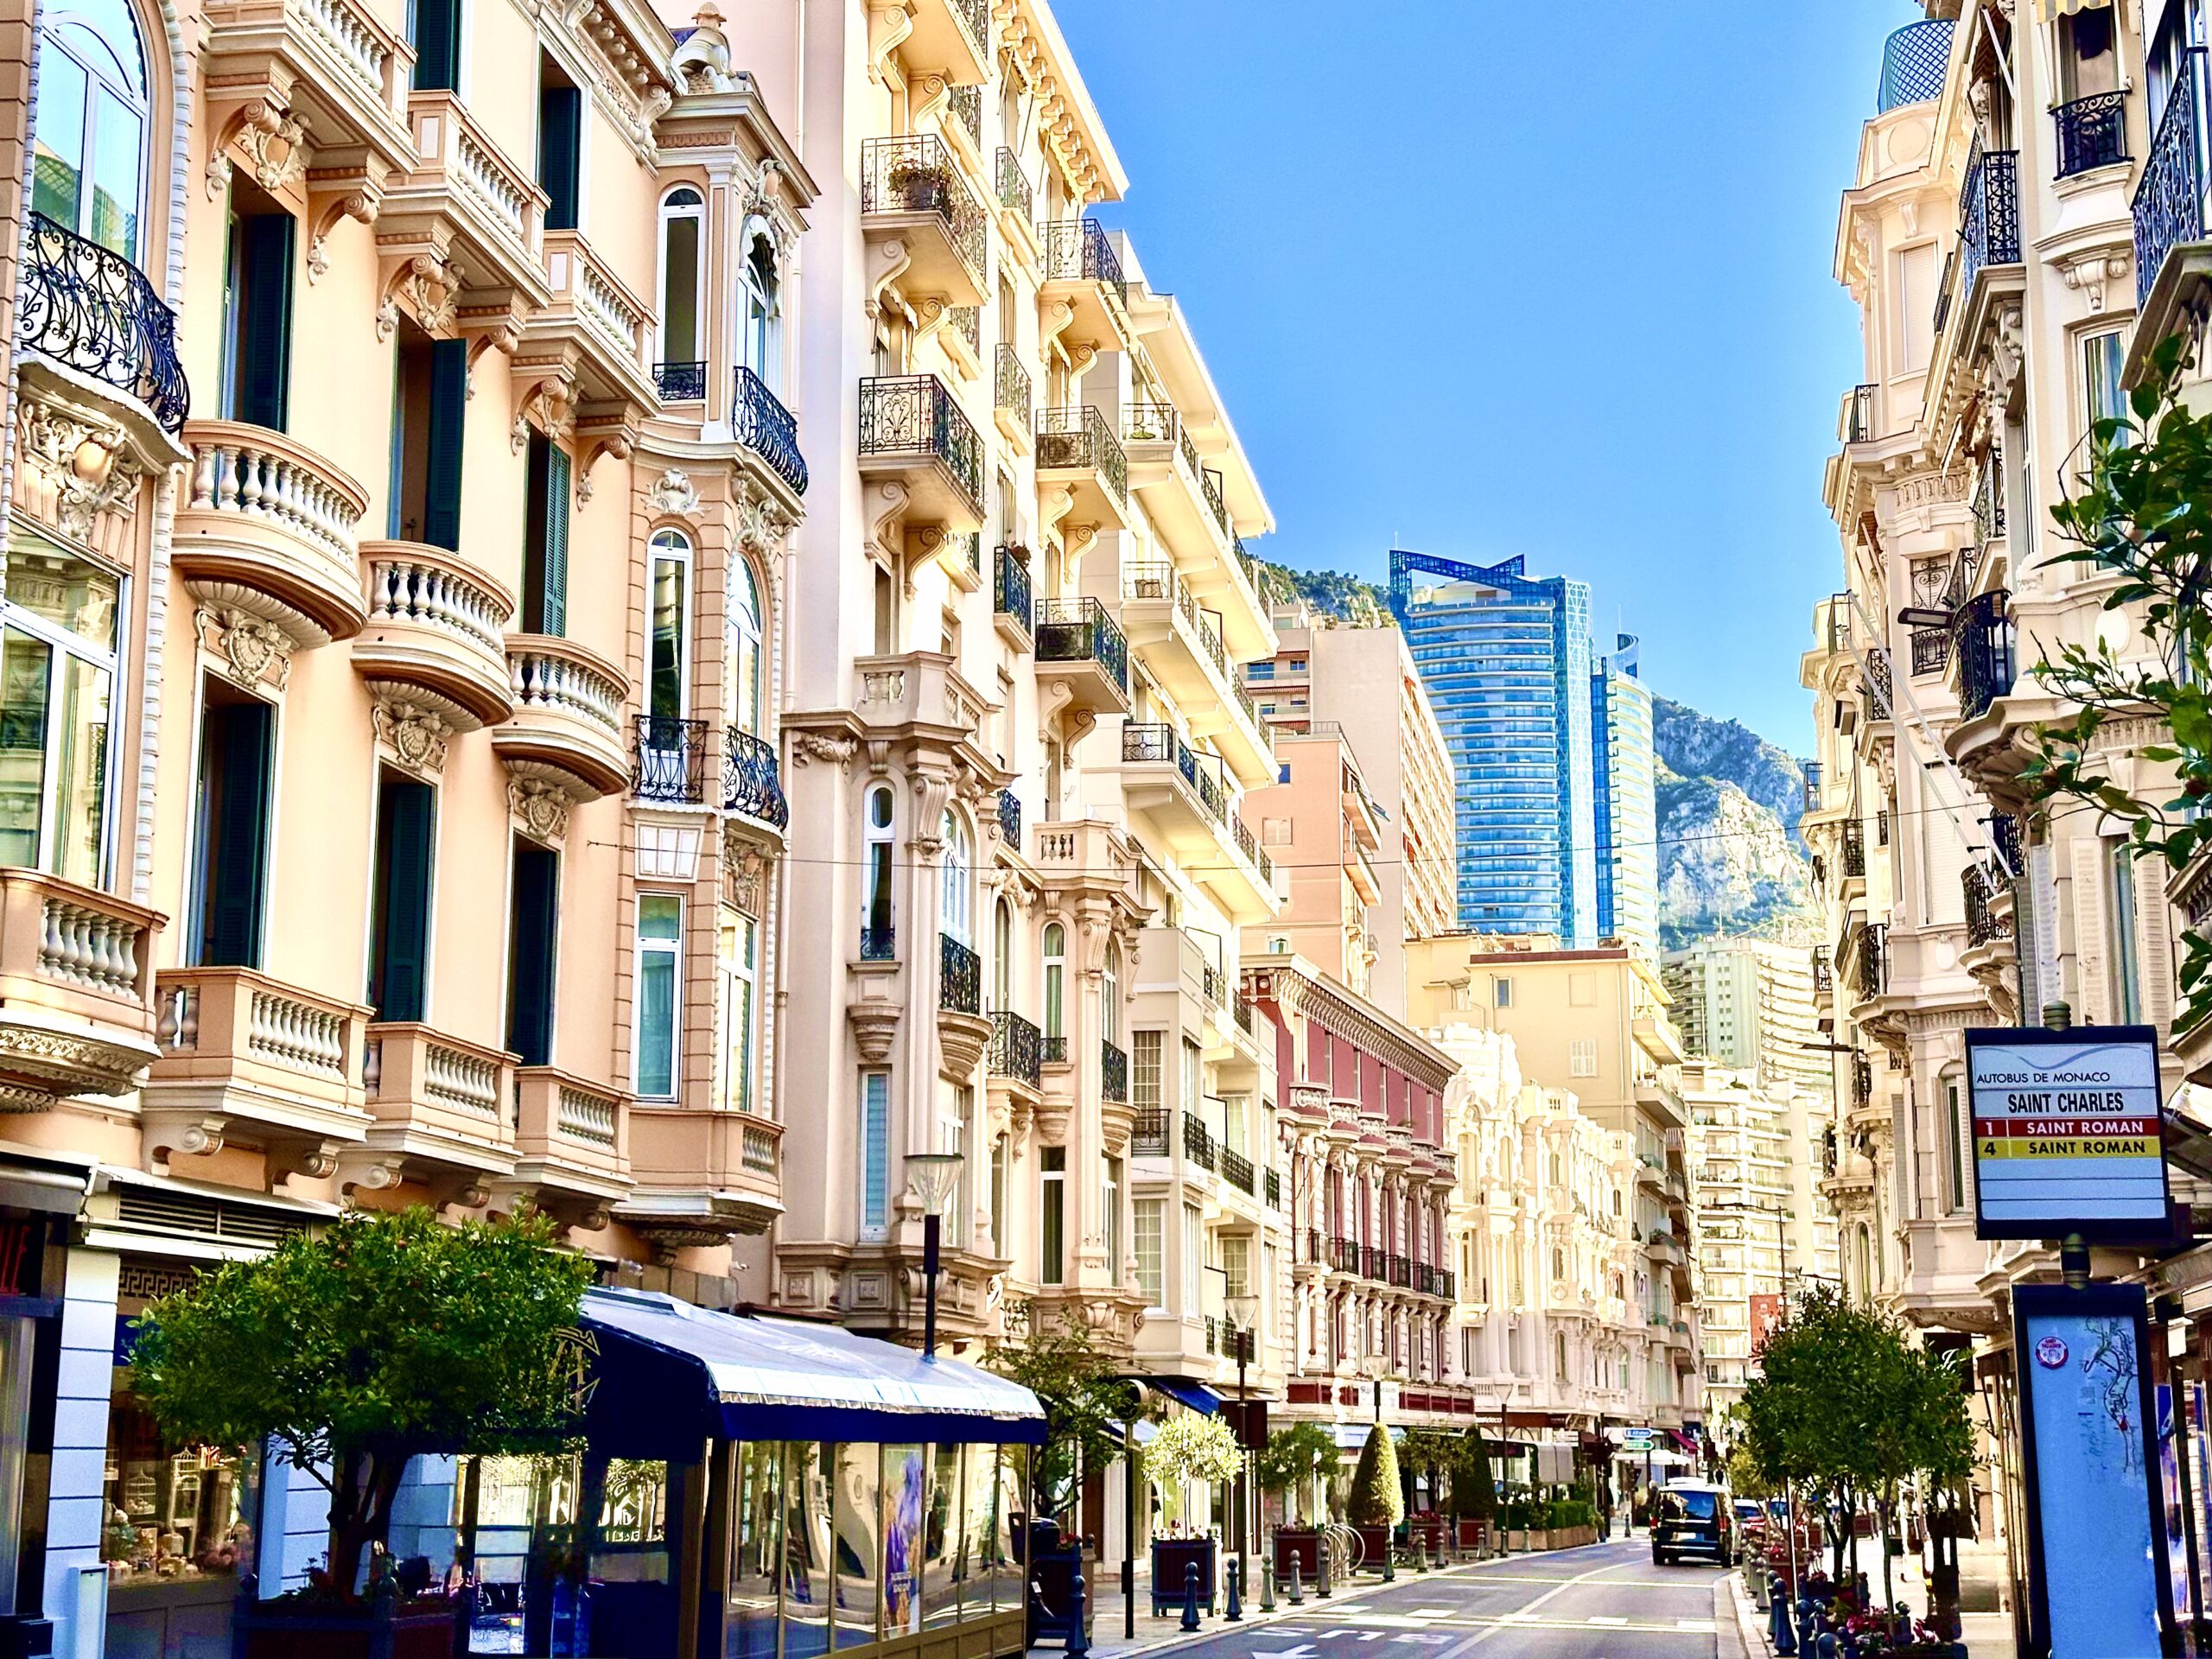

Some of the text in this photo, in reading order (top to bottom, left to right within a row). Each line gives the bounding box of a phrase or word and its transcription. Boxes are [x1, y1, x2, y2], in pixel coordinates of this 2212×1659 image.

[1977, 1072, 2110, 1084] AUTOBUS DE MONACO
[2008, 1092, 2124, 1113] SAINT CHARLES
[1986, 1122, 2144, 1135] 1 SAINT ROMAN
[1984, 1141, 2145, 1155] 4 SAINT ROMAN
